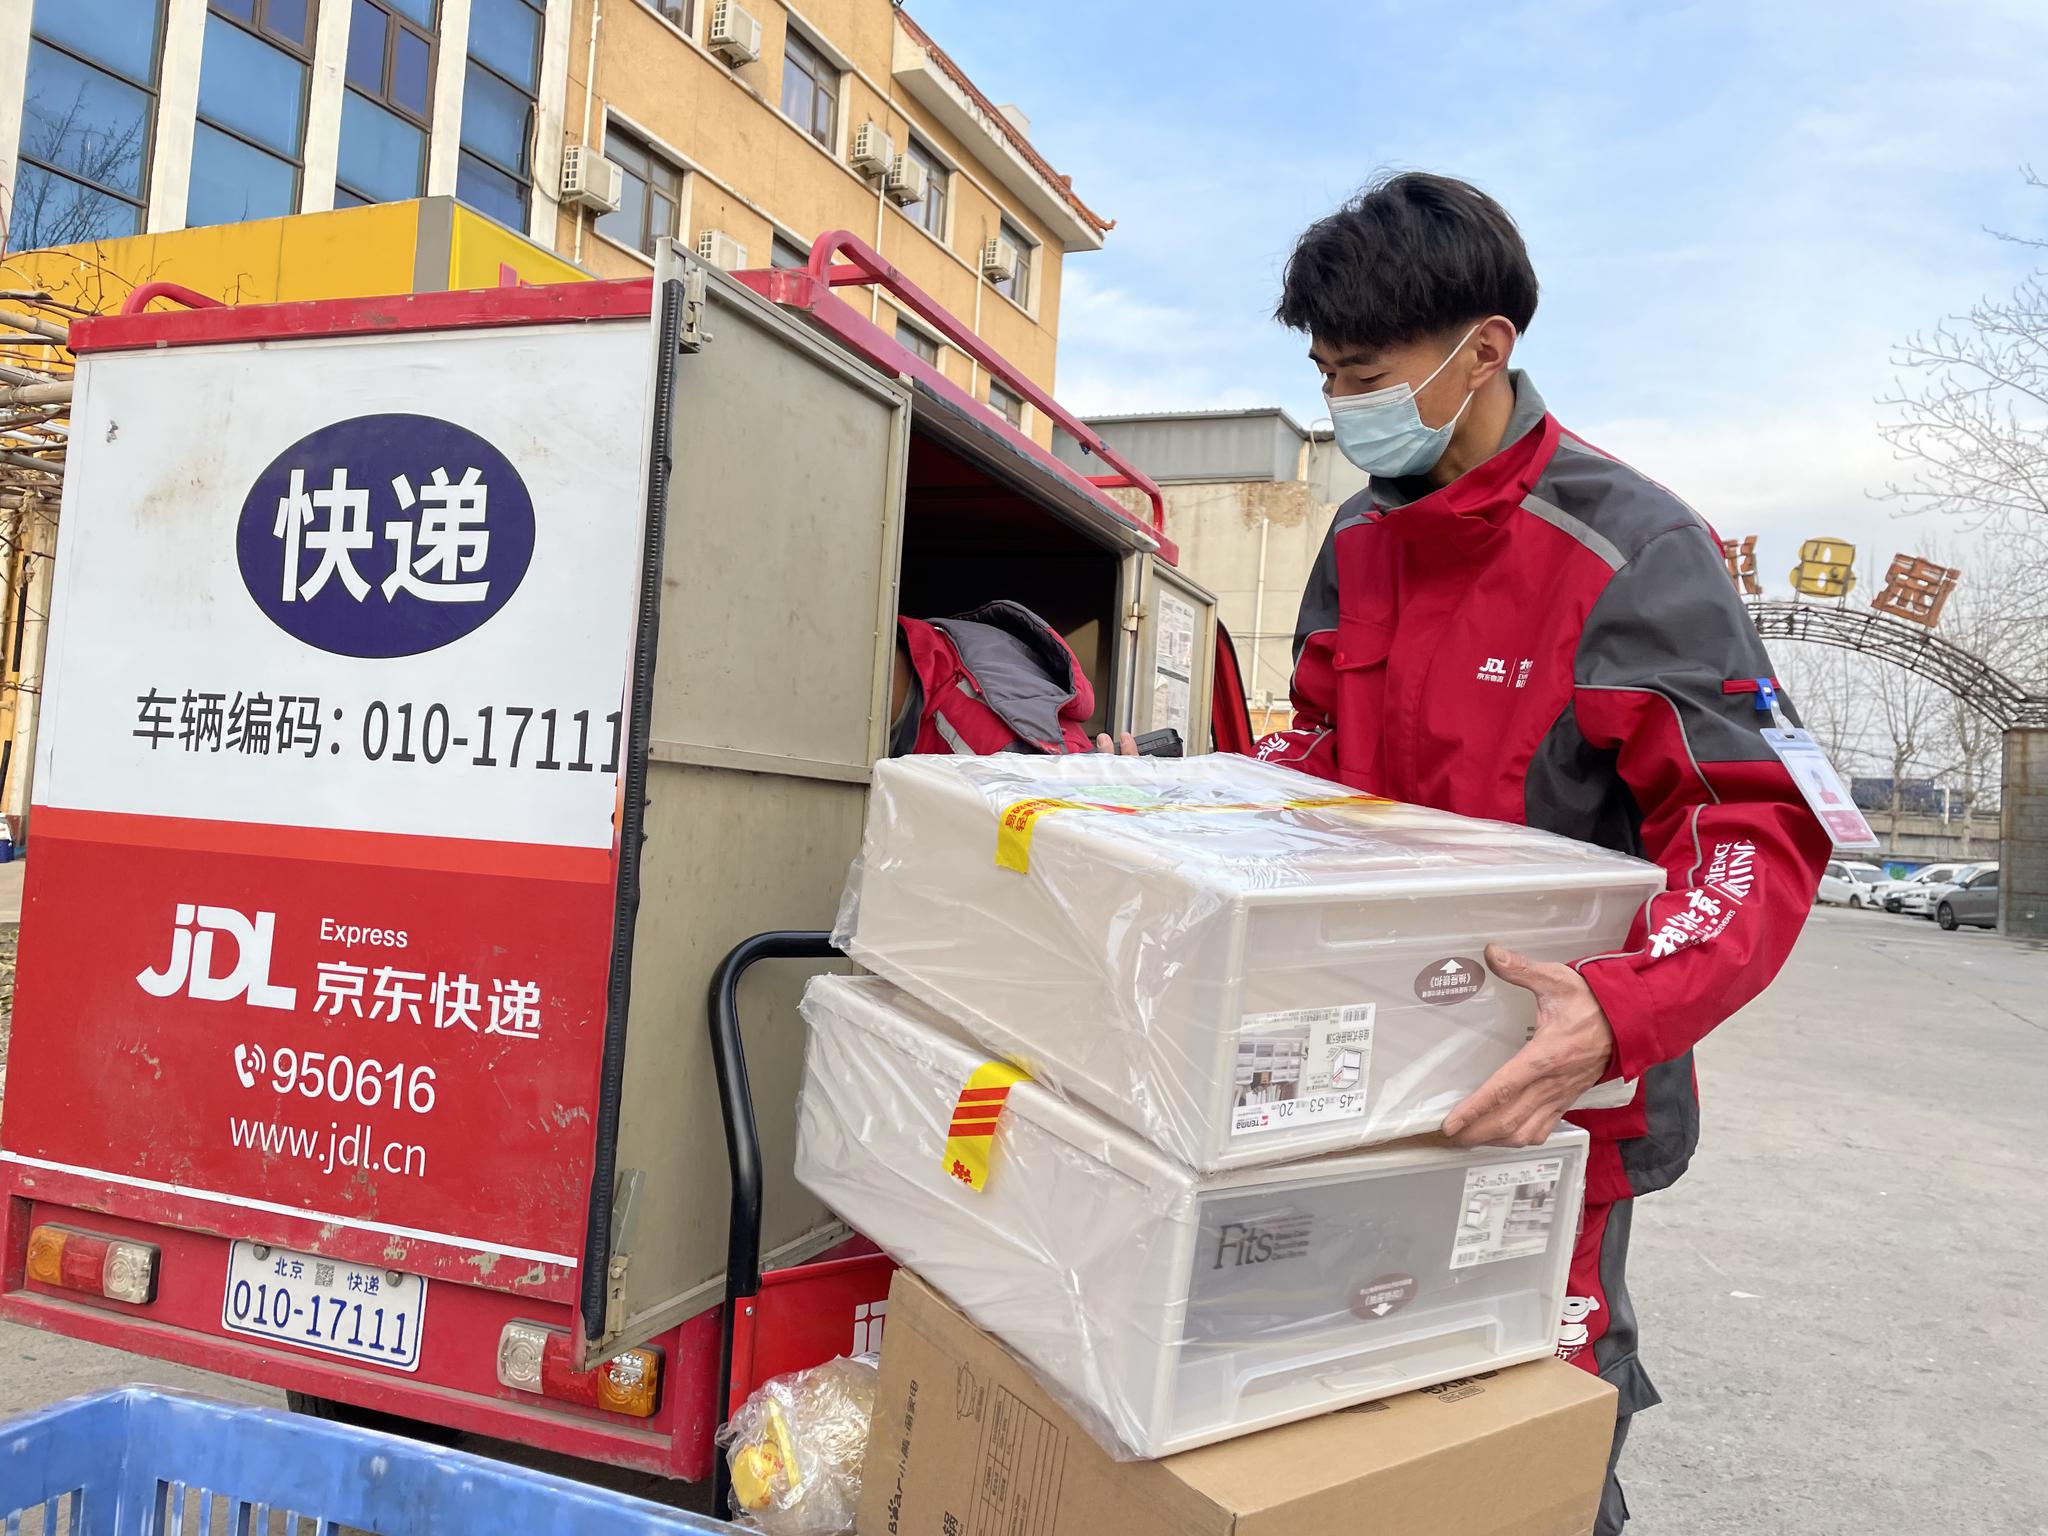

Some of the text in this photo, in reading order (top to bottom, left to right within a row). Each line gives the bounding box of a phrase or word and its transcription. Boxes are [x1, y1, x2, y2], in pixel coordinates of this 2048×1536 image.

[273, 466, 490, 603] 快递
[1479, 657, 1507, 675] JDL
[136, 903, 296, 1010] JDL
[320, 918, 409, 949] Express
[313, 960, 542, 1040] 京东快递
[272, 1047, 437, 1114] 950616
[230, 1116, 427, 1178] www.jdl.cn
[274, 1256, 380, 1296] 北京 快递
[1212, 1223, 1274, 1270] Fits
[233, 1281, 408, 1356] 010-17111
